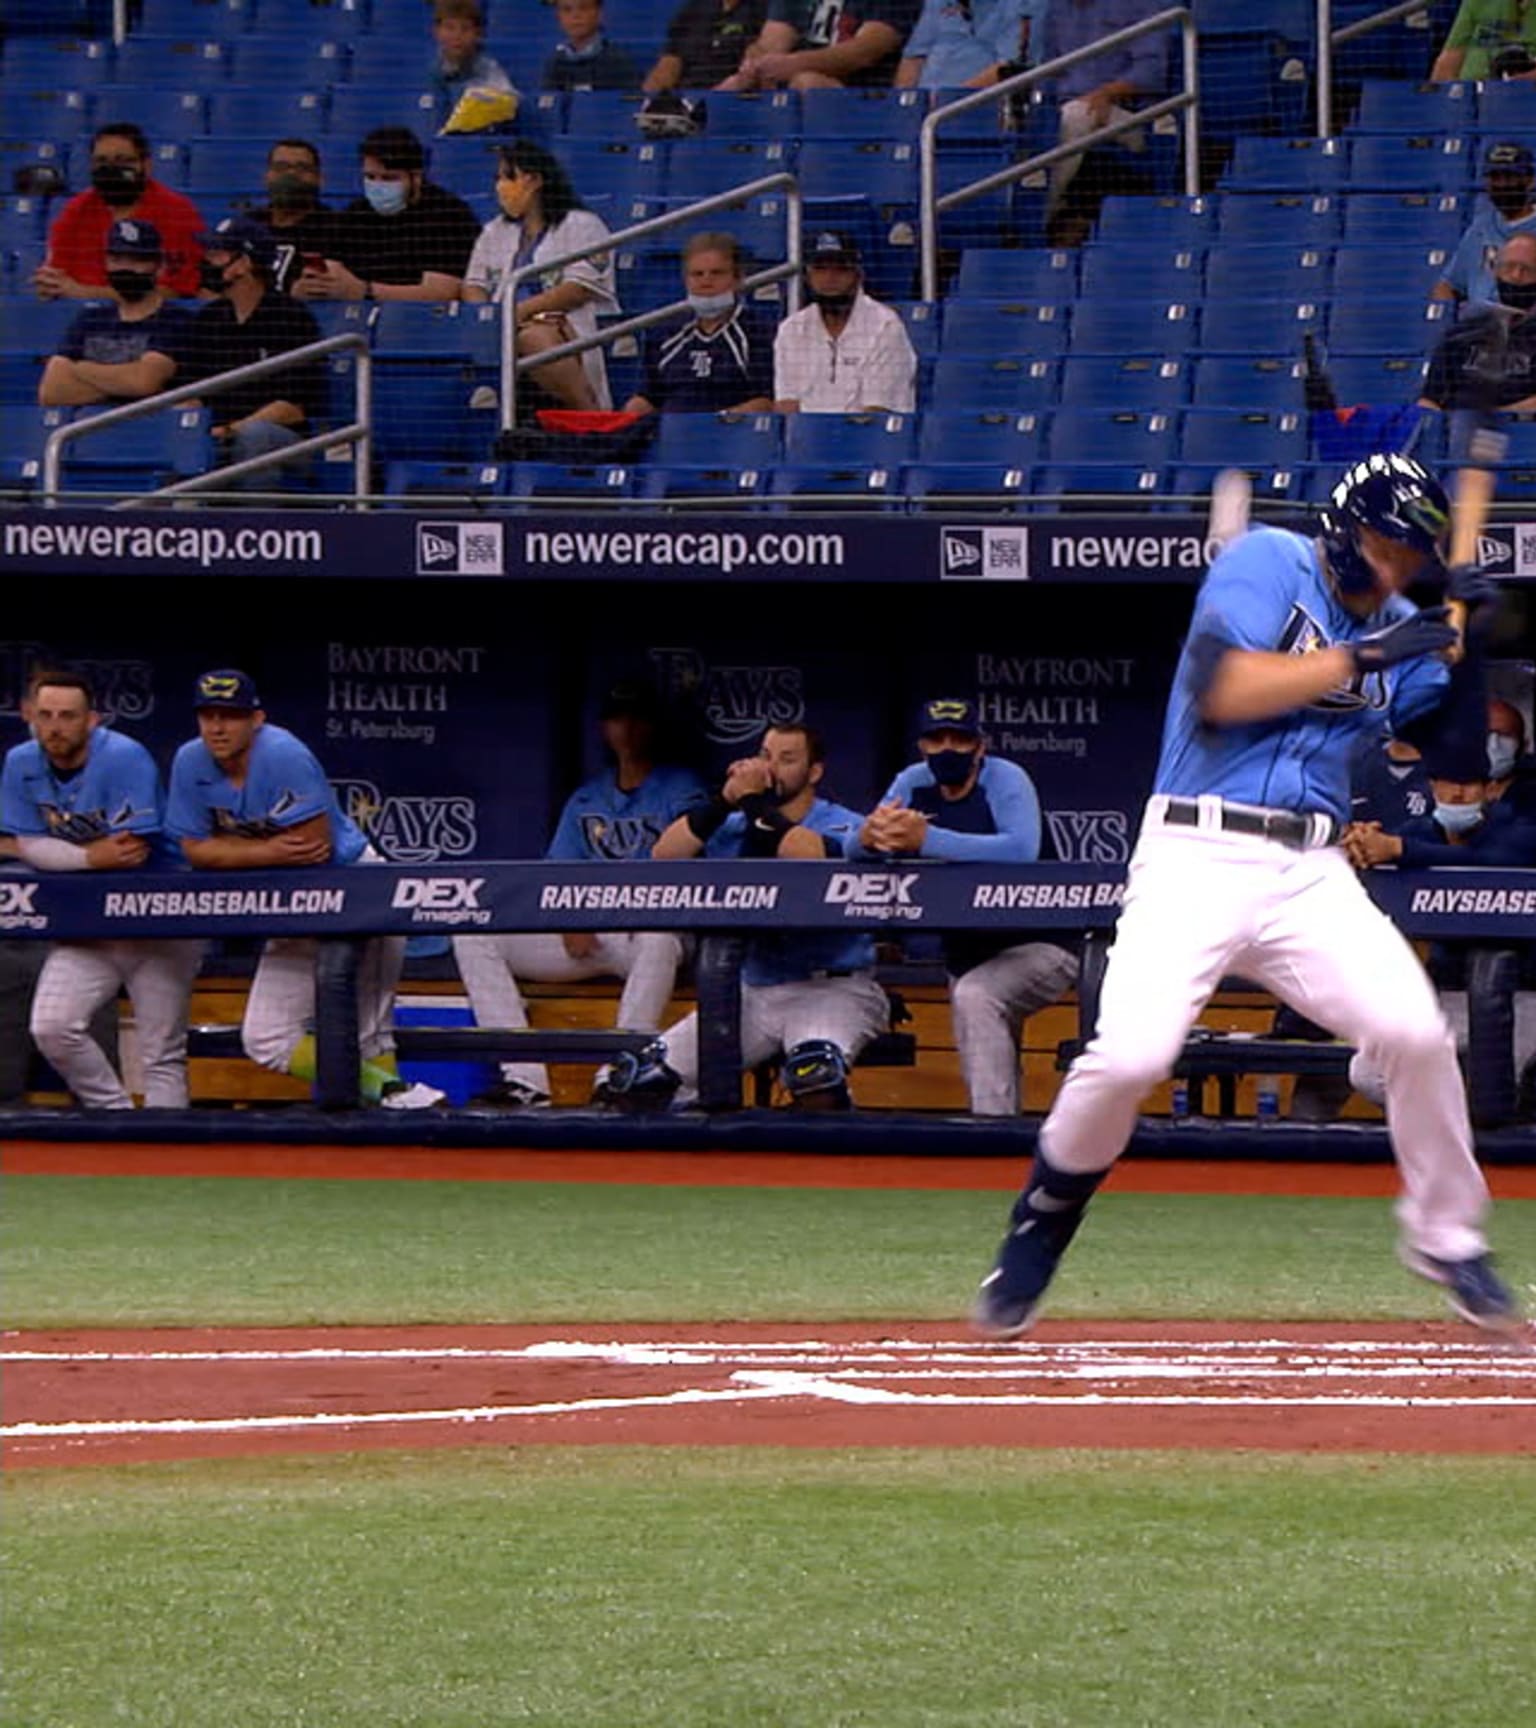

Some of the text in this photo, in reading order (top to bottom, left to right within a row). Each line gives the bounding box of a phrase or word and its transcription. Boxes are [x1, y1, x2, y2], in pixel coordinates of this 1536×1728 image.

[4, 523, 322, 567] neweracap.com
[525, 531, 844, 572] neweracap.com
[1051, 536, 1226, 568] newerac
[351, 717, 435, 744] Petersburg
[392, 878, 486, 908] DEX
[540, 884, 778, 910] RAYSBASEBALL.COM
[824, 873, 920, 903] DEX
[104, 889, 345, 917] RAYSBASEBALL.COM
[412, 907, 491, 925] imaging
[845, 902, 924, 920] imaging
